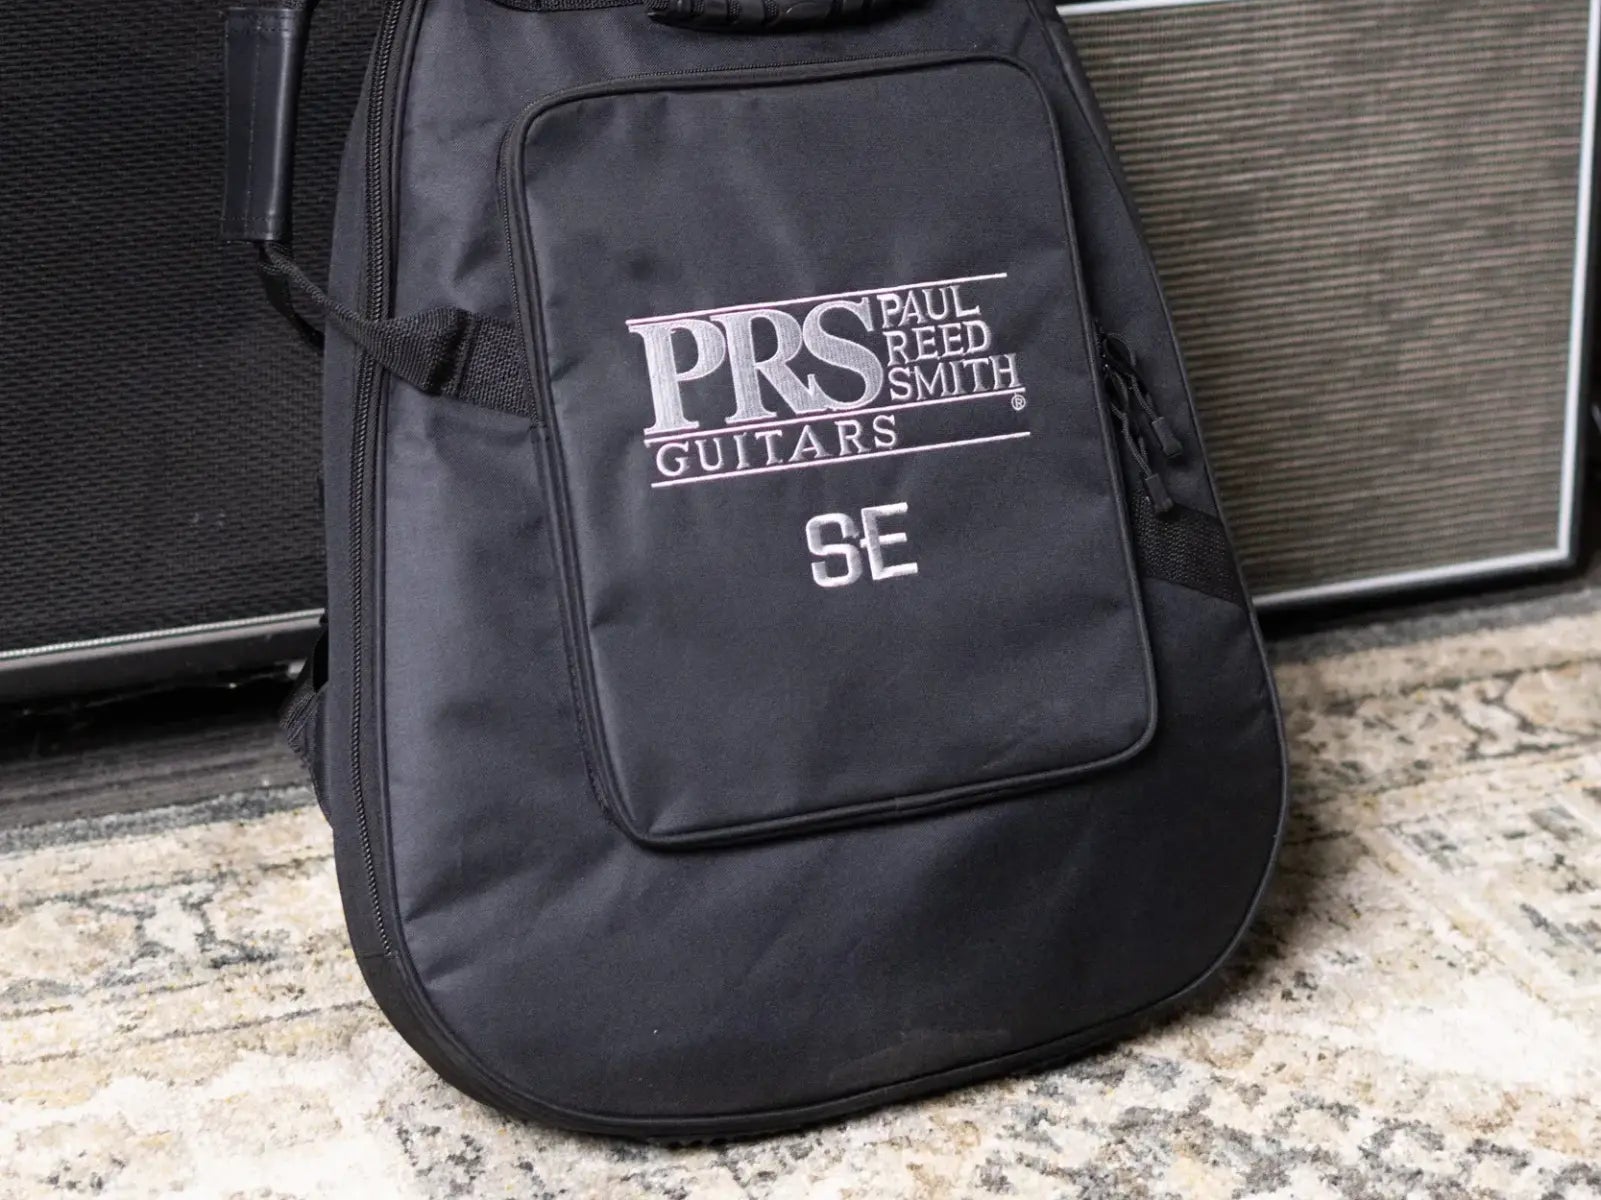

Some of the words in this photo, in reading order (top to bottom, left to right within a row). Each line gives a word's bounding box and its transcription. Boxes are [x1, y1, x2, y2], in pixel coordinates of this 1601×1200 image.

[876, 284, 981, 330] PAUL
[629, 296, 885, 436] PRS
[882, 319, 993, 367] REED
[888, 352, 1022, 402] SMITH
[656, 413, 899, 477] GUITARS
[805, 502, 919, 588] SE
